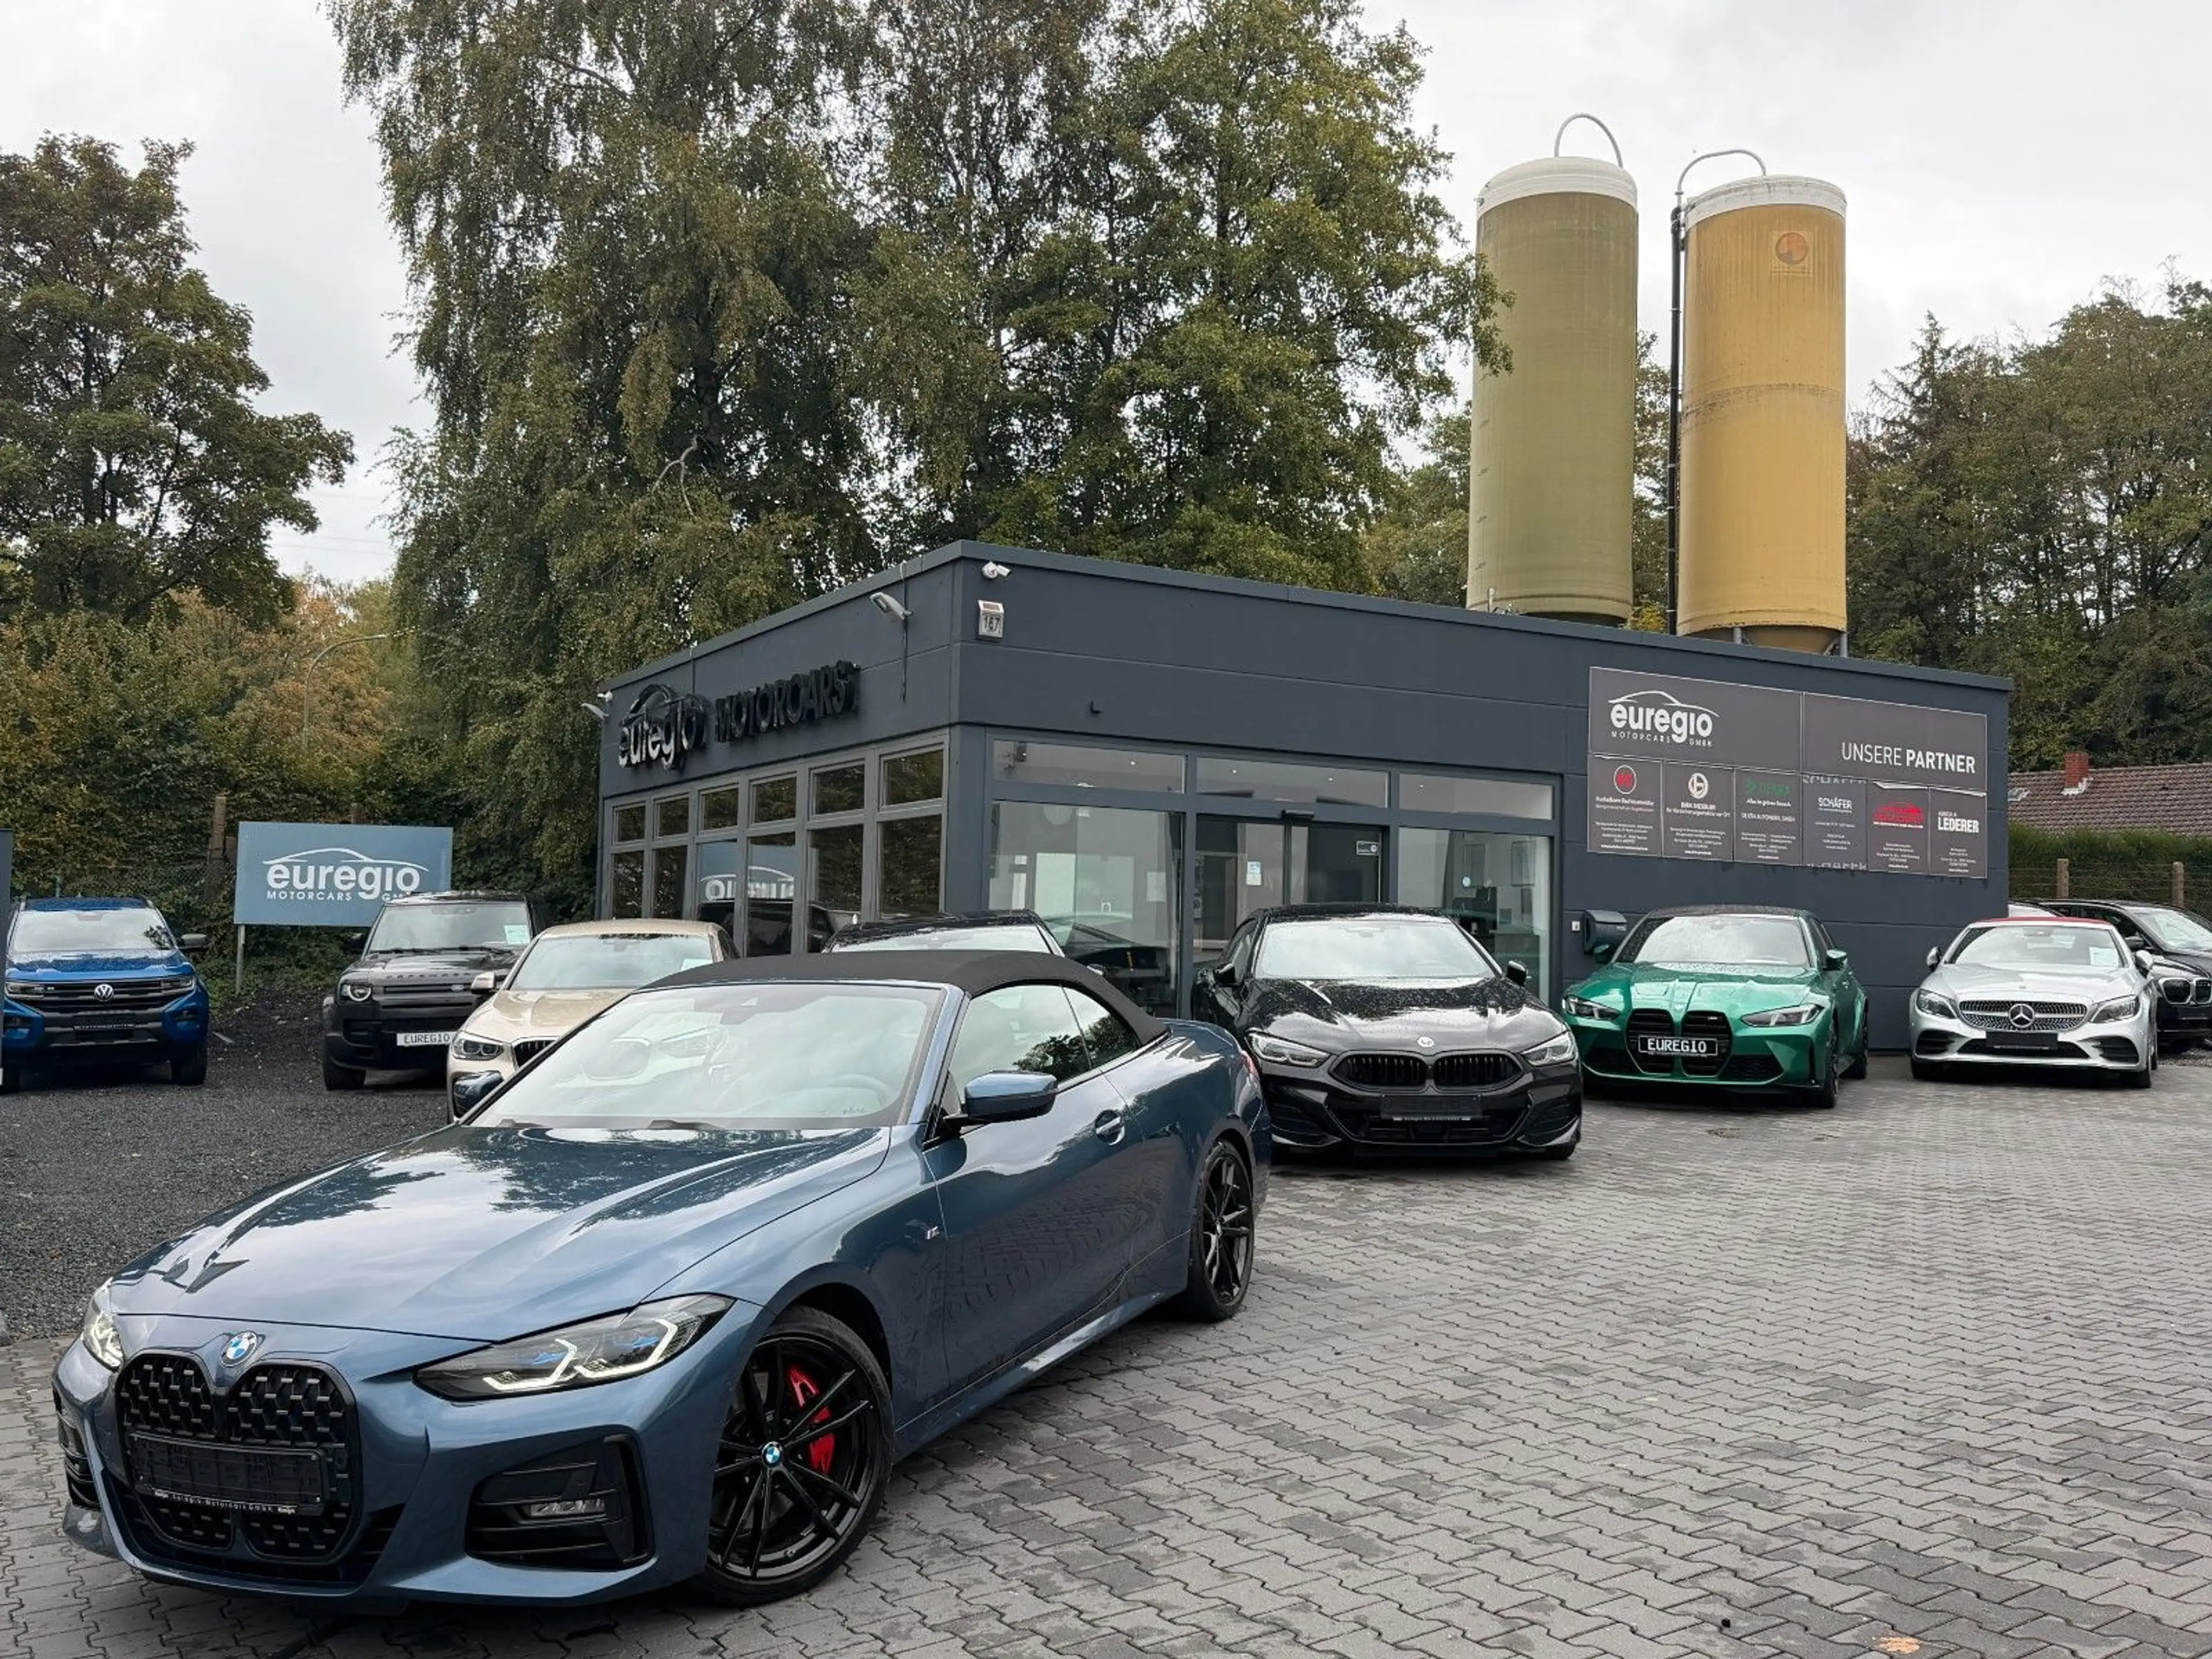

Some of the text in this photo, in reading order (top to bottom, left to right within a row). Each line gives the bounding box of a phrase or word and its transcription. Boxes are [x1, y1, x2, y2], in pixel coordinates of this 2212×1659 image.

[1611, 703, 1713, 743] euregio
[619, 695, 706, 771] euregio
[1611, 730, 1671, 743] MOTORCARS
[1842, 742, 1975, 774] UNSERE PARTNER
[1938, 817, 1979, 833] LEDERER
[266, 864, 420, 900] euregio
[266, 891, 353, 902] MOTORCARS
[404, 1033, 450, 1044] EUREGIO
[1647, 1038, 1707, 1053] EUREGIO
